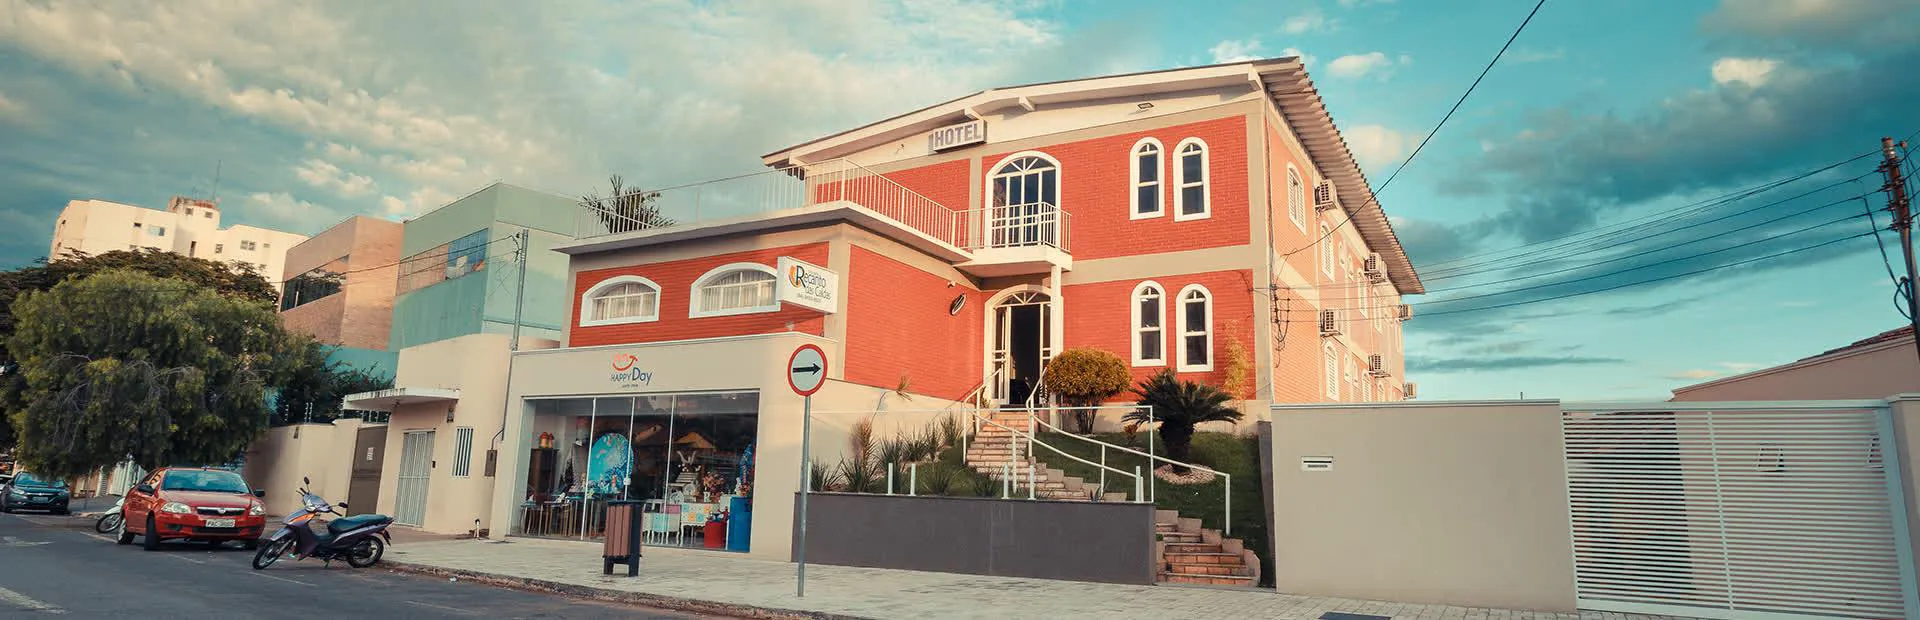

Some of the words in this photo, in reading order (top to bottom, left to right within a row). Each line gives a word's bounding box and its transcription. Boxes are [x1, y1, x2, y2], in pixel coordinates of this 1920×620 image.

[934, 123, 982, 148] HOTEL
[796, 265, 826, 288] Recanto
[610, 371, 632, 382] HAPPY
[632, 366, 652, 386] Day
